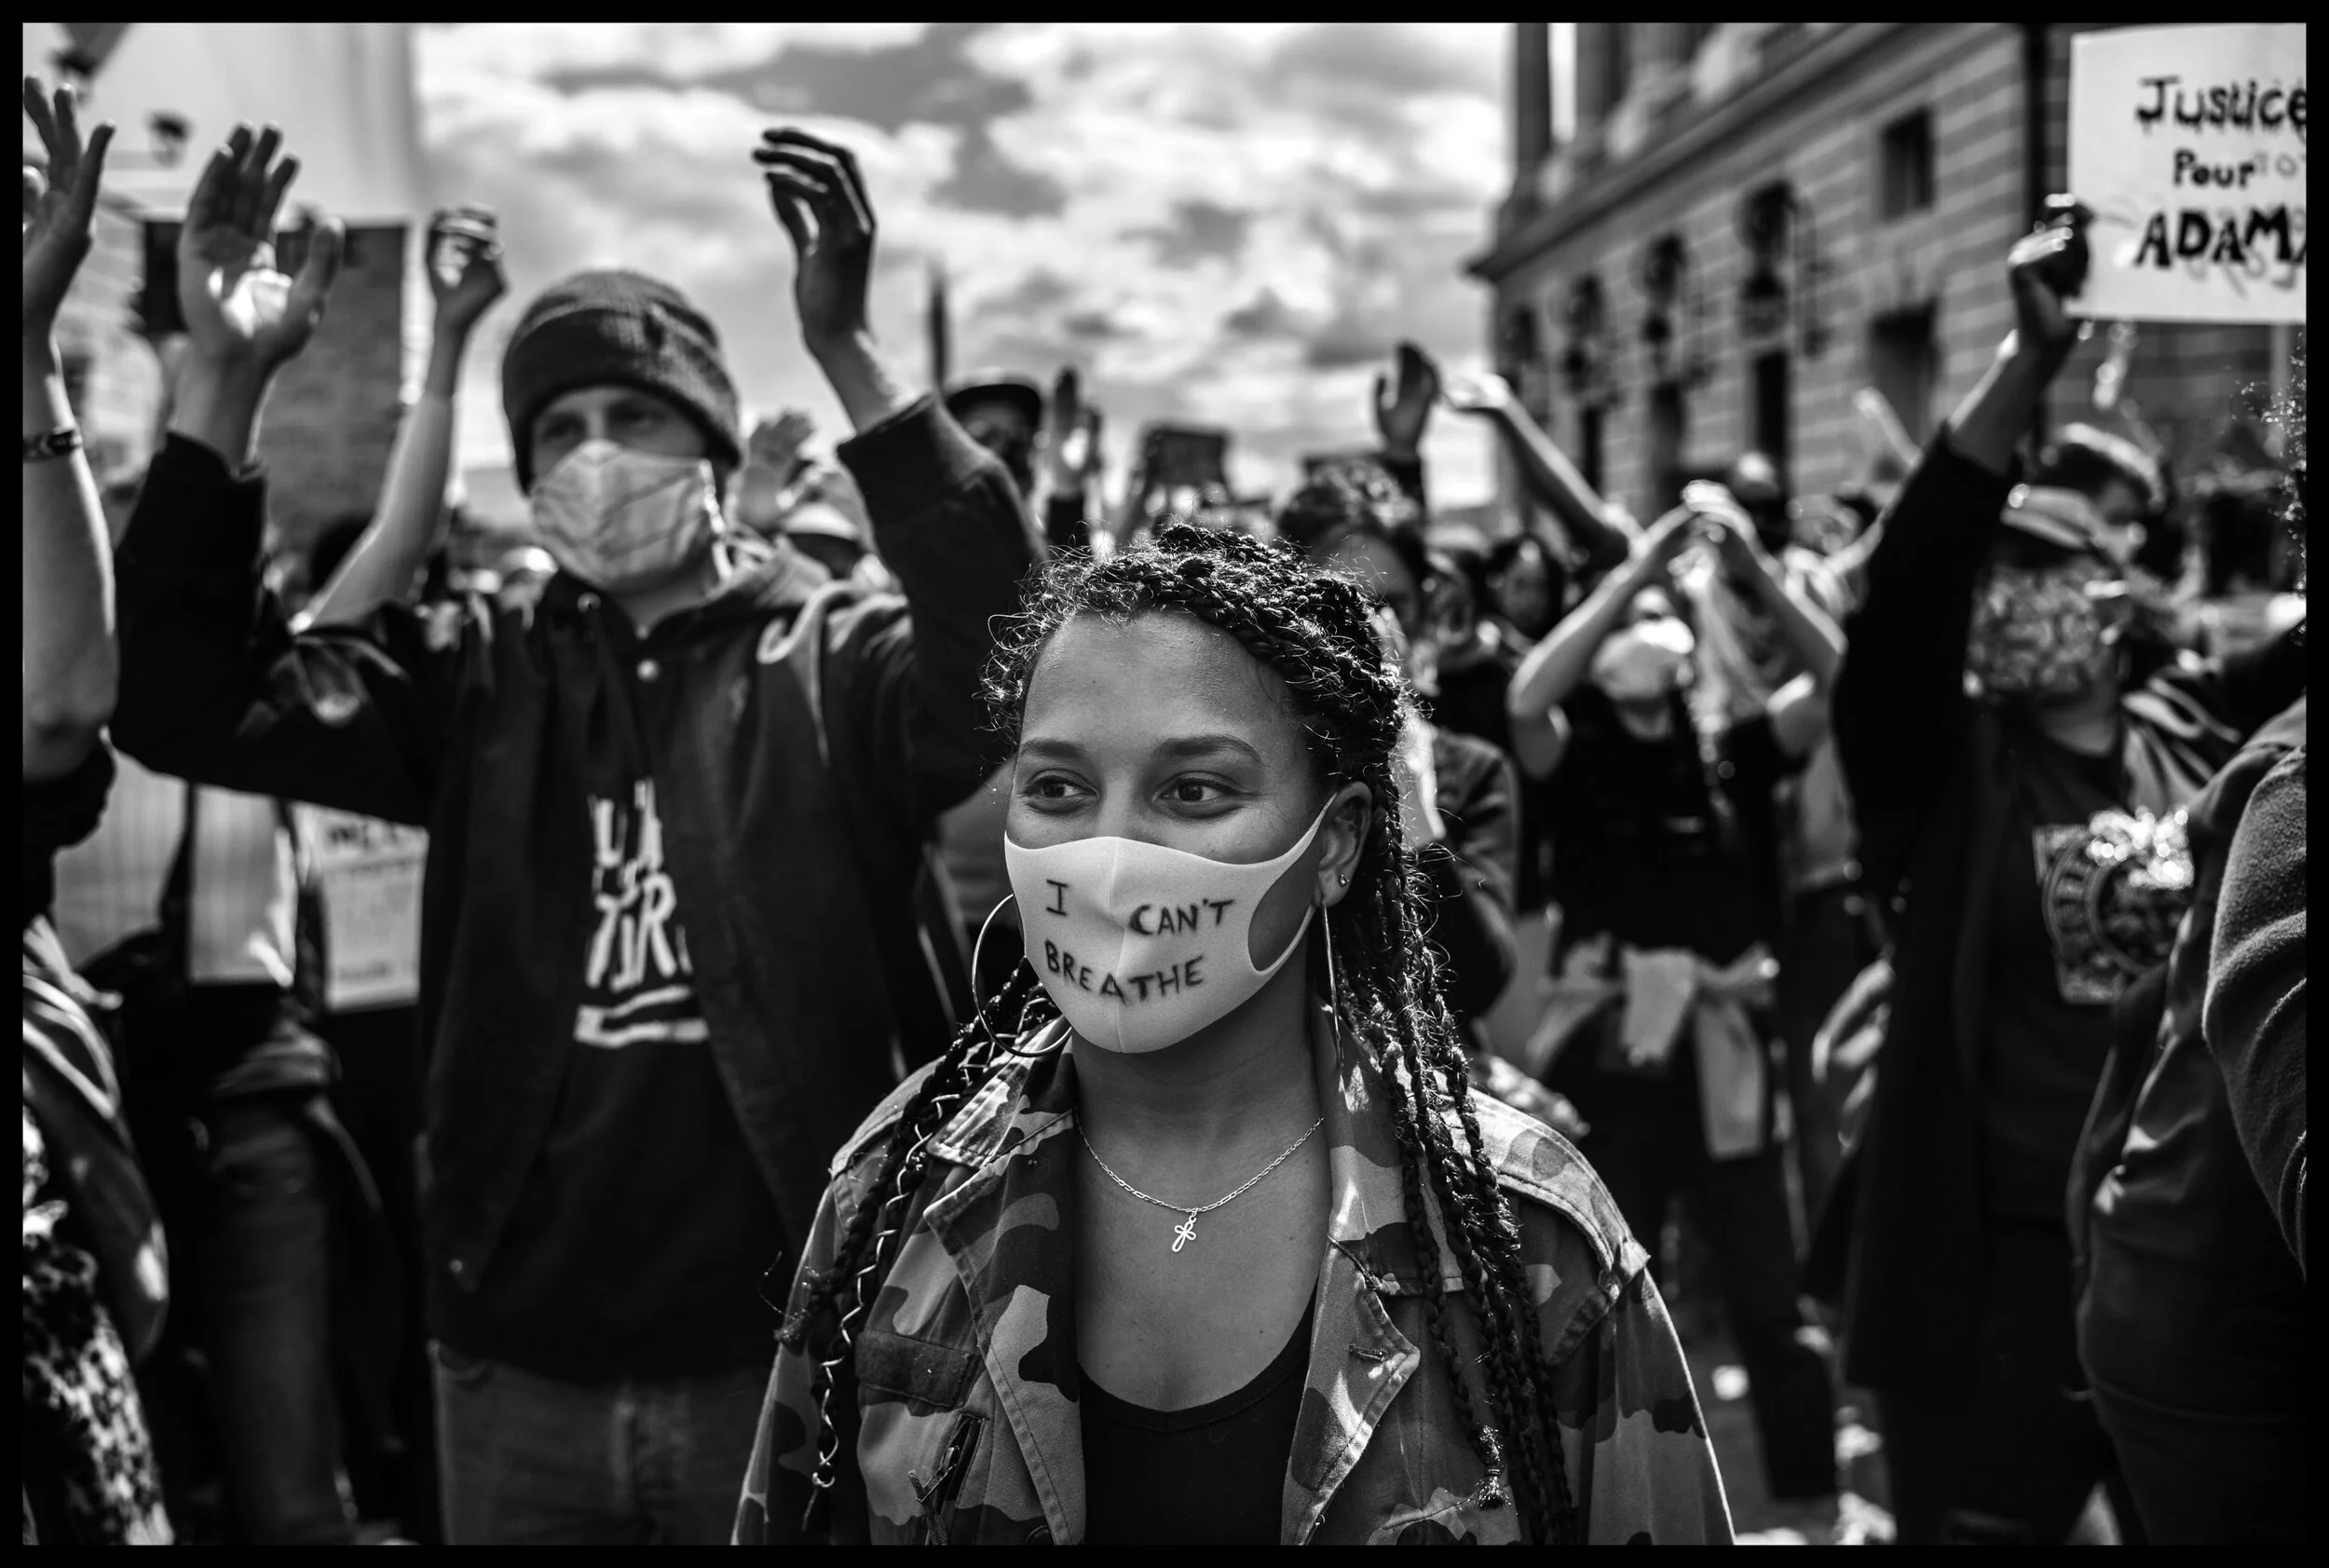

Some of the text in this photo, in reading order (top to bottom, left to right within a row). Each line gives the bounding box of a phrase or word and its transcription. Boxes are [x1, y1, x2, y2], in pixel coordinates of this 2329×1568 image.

[2136, 75, 2307, 135] Justice
[2174, 149, 2254, 187] Pour
[2135, 206, 2307, 268] ADAM
[1045, 879, 1234, 935] I CAN'T
[1043, 939, 1205, 1004] BREATHE
